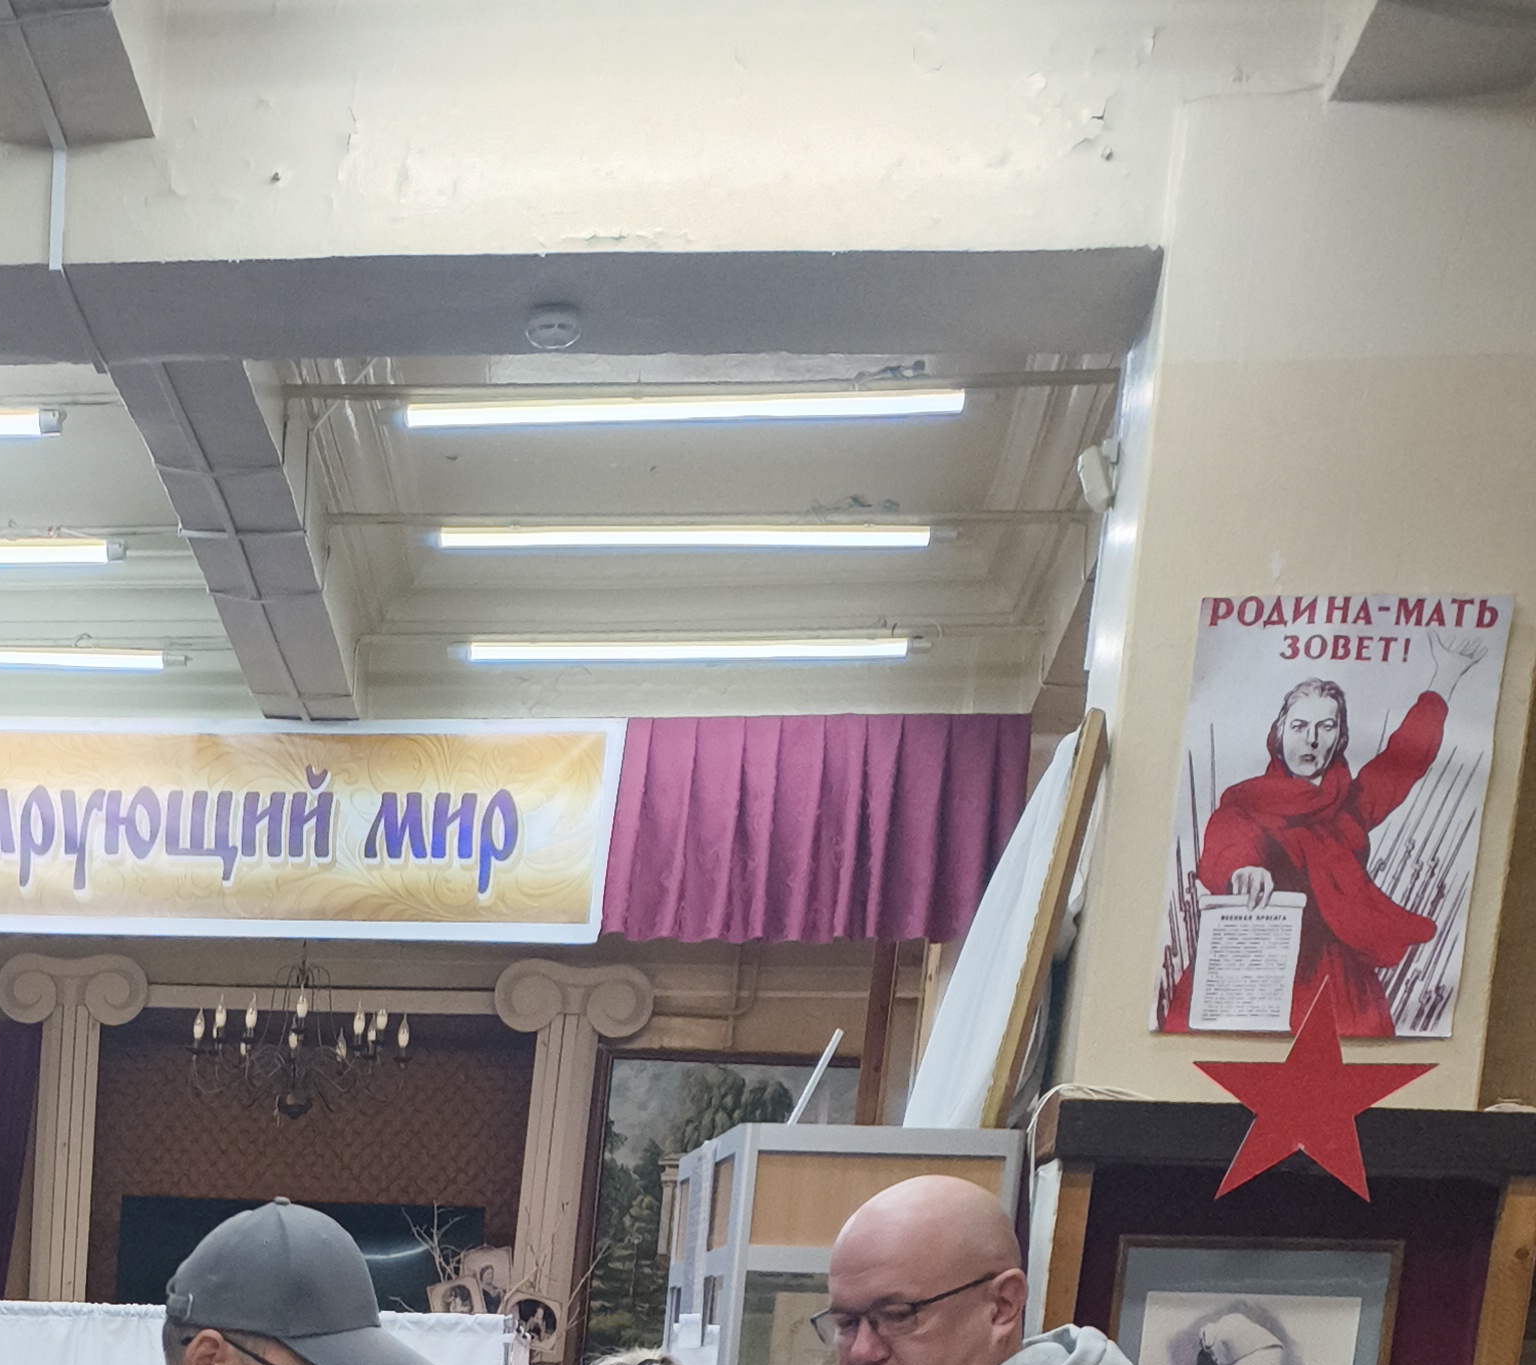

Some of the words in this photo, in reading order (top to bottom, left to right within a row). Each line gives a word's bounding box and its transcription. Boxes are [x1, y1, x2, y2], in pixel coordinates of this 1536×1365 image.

[1208, 596, 1499, 629] РОДИНА-МАТЬ
[1279, 634, 1411, 663] ЗОВЕТ!
[364, 788, 519, 893] мир
